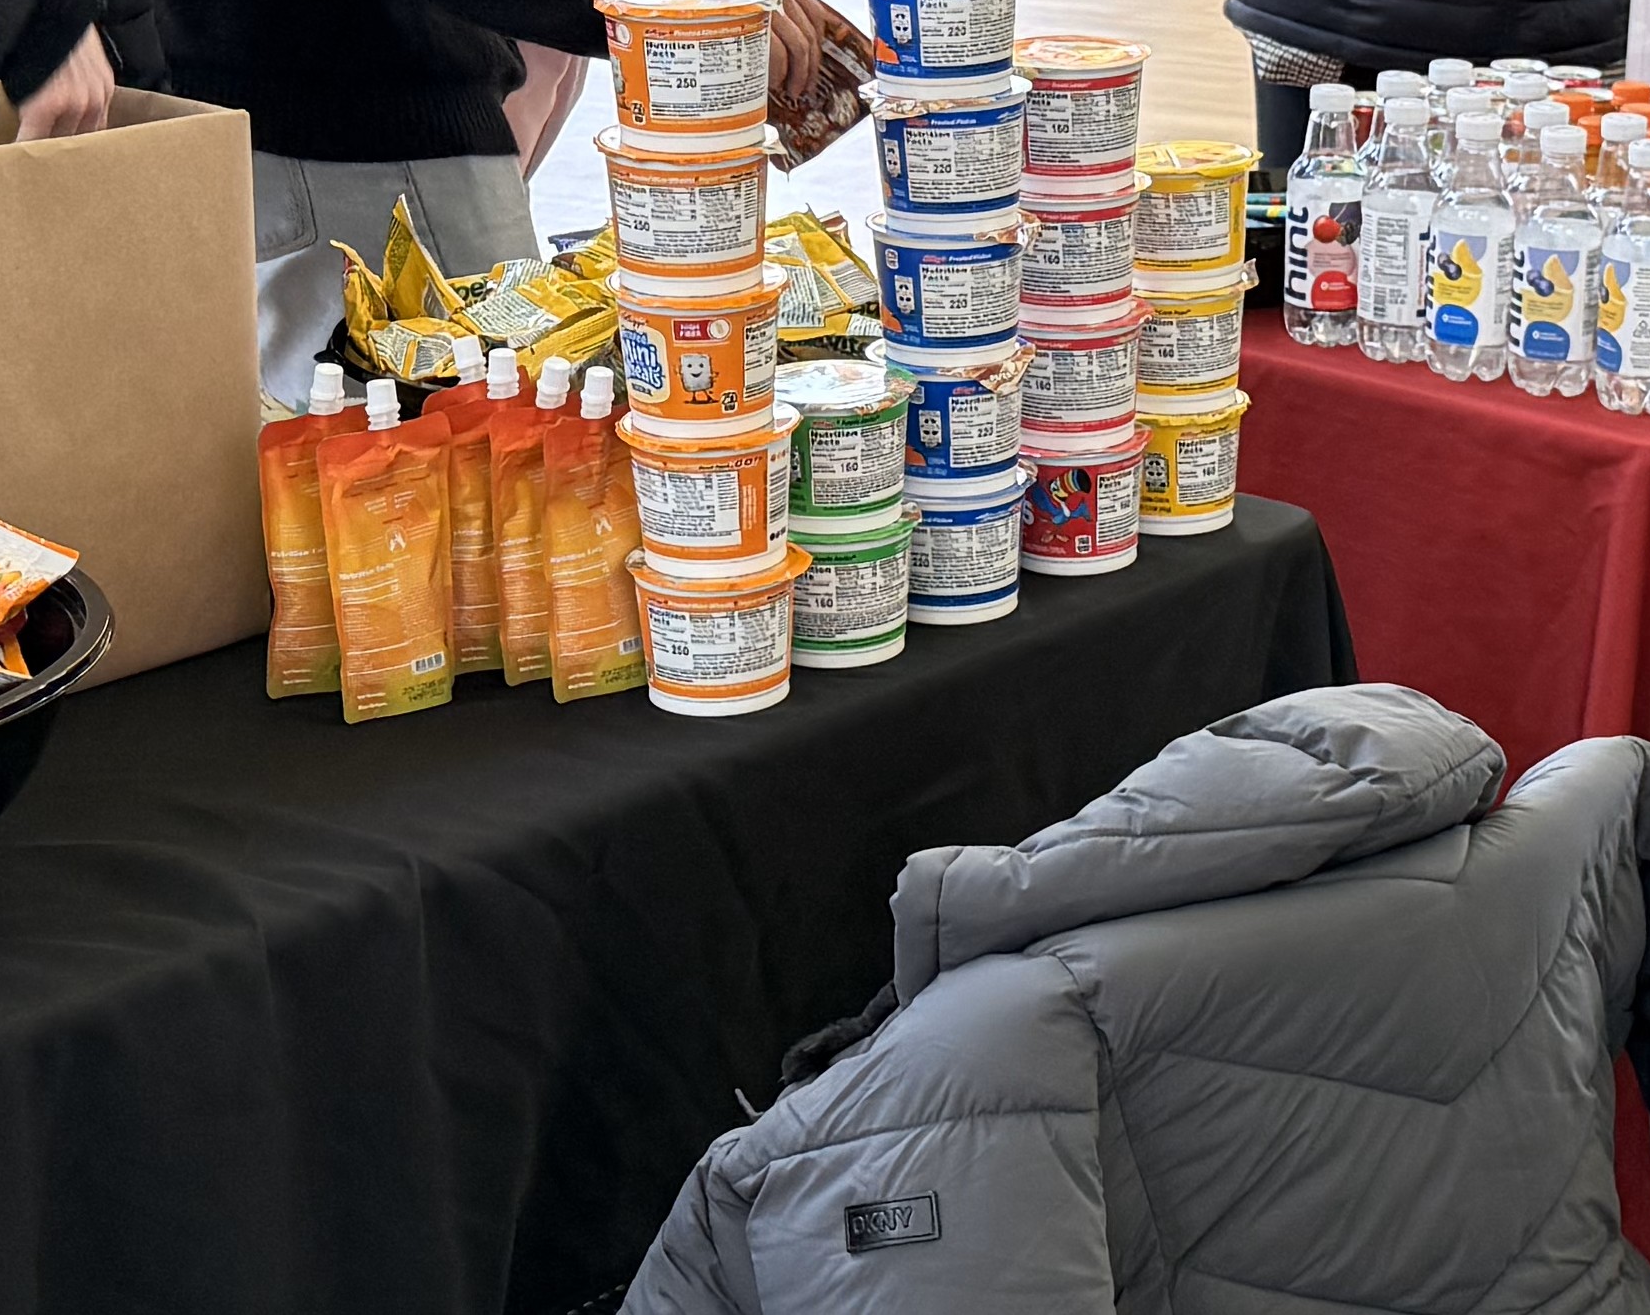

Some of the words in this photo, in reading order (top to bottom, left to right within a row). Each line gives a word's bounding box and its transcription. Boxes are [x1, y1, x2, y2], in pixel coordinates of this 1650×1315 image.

[676, 77, 697, 89] 250
[933, 164, 952, 174] 220
[1284, 205, 1309, 302] hint
[810, 429, 858, 438] Nutrition
[840, 461, 859, 472] 160
[852, 1206, 913, 1235] DKNY
